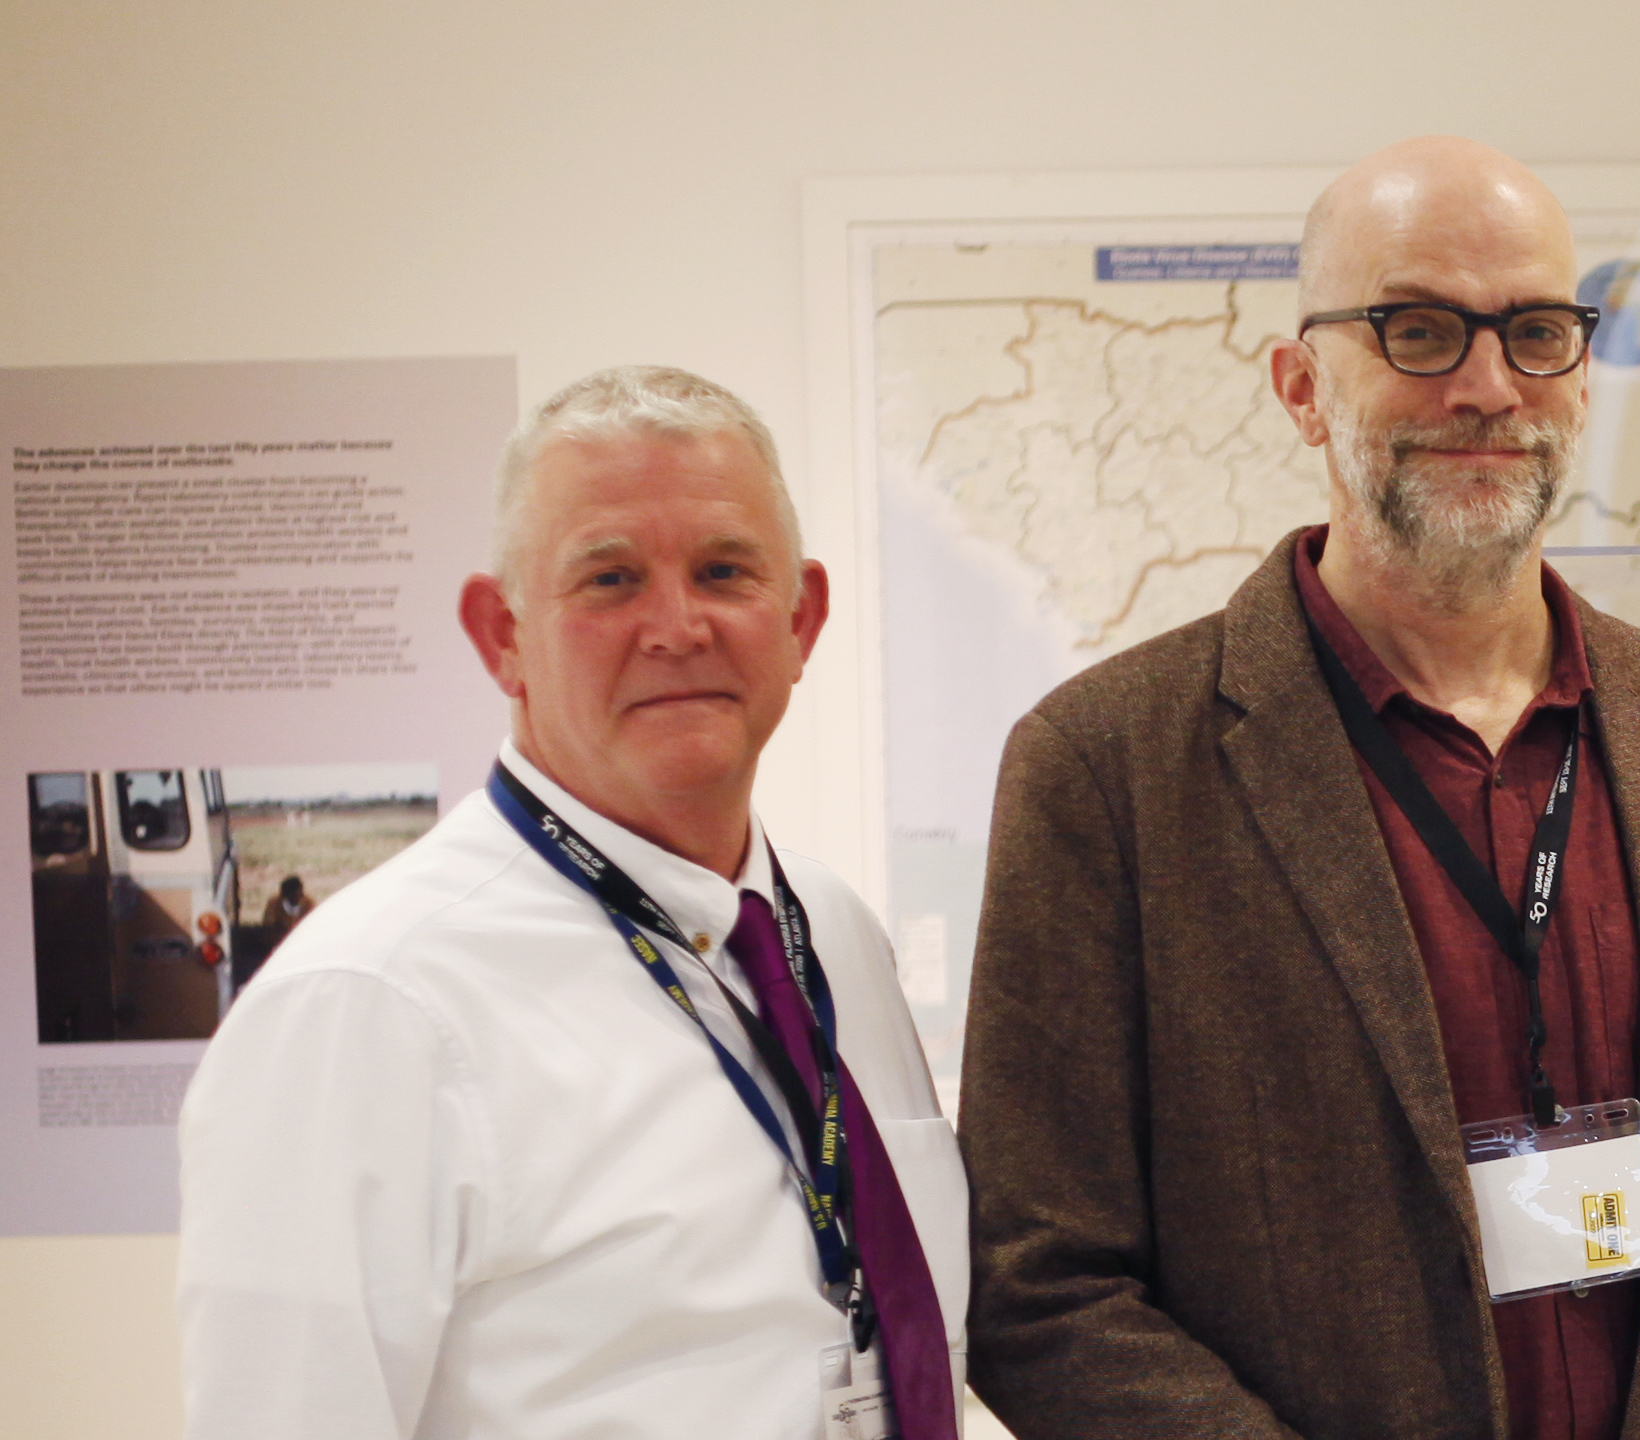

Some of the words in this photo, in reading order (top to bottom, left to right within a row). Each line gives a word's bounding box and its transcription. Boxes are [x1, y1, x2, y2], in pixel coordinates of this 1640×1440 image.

[566, 835, 592, 860] YEARS
[591, 858, 605, 870] OF
[1537, 851, 1546, 865] OF
[1534, 865, 1546, 894] YEARS
[1541, 851, 1558, 901] RESEARCH
[1529, 901, 1548, 924] 50
[820, 1120, 837, 1166] ACADEMY
